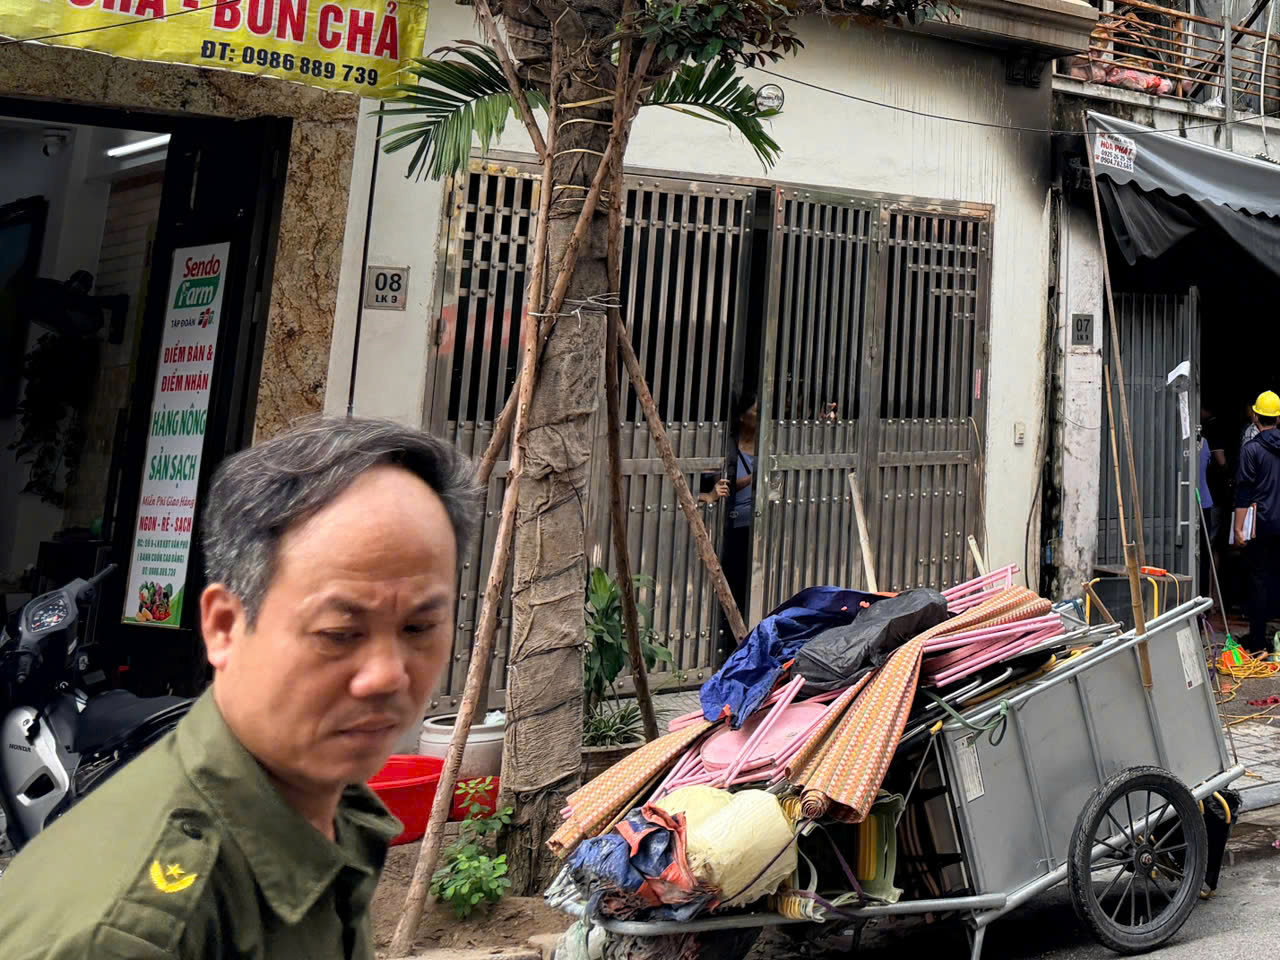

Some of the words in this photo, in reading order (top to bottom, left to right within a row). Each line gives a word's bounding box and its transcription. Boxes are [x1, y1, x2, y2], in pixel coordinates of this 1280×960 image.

[317, 0, 401, 60] CHẢ
[201, 39, 236, 62] ĐT:
[241, 45, 296, 72] 0986
[300, 53, 336, 79] 889
[342, 64, 379, 86] 739
[183, 254, 221, 279] Sendo
[177, 281, 214, 306] Farm
[375, 272, 402, 292] 08
[375, 294, 388, 303] LK
[1076, 318, 1090, 332] 07
[163, 340, 186, 364] ĐIỂM
[187, 342, 206, 362] BÁN
[206, 344, 214, 361] &
[161, 368, 184, 392] ĐIỂM
[184, 370, 209, 394] NHẬN
[151, 403, 180, 437] HÀNG
[180, 403, 207, 436] NÔNG
[149, 446, 170, 481] SẢN
[169, 454, 198, 488] SẠCH
[138, 516, 158, 531] NGON
[174, 517, 192, 535] SẠCH
[9, 743, 32, 753] HONDA
